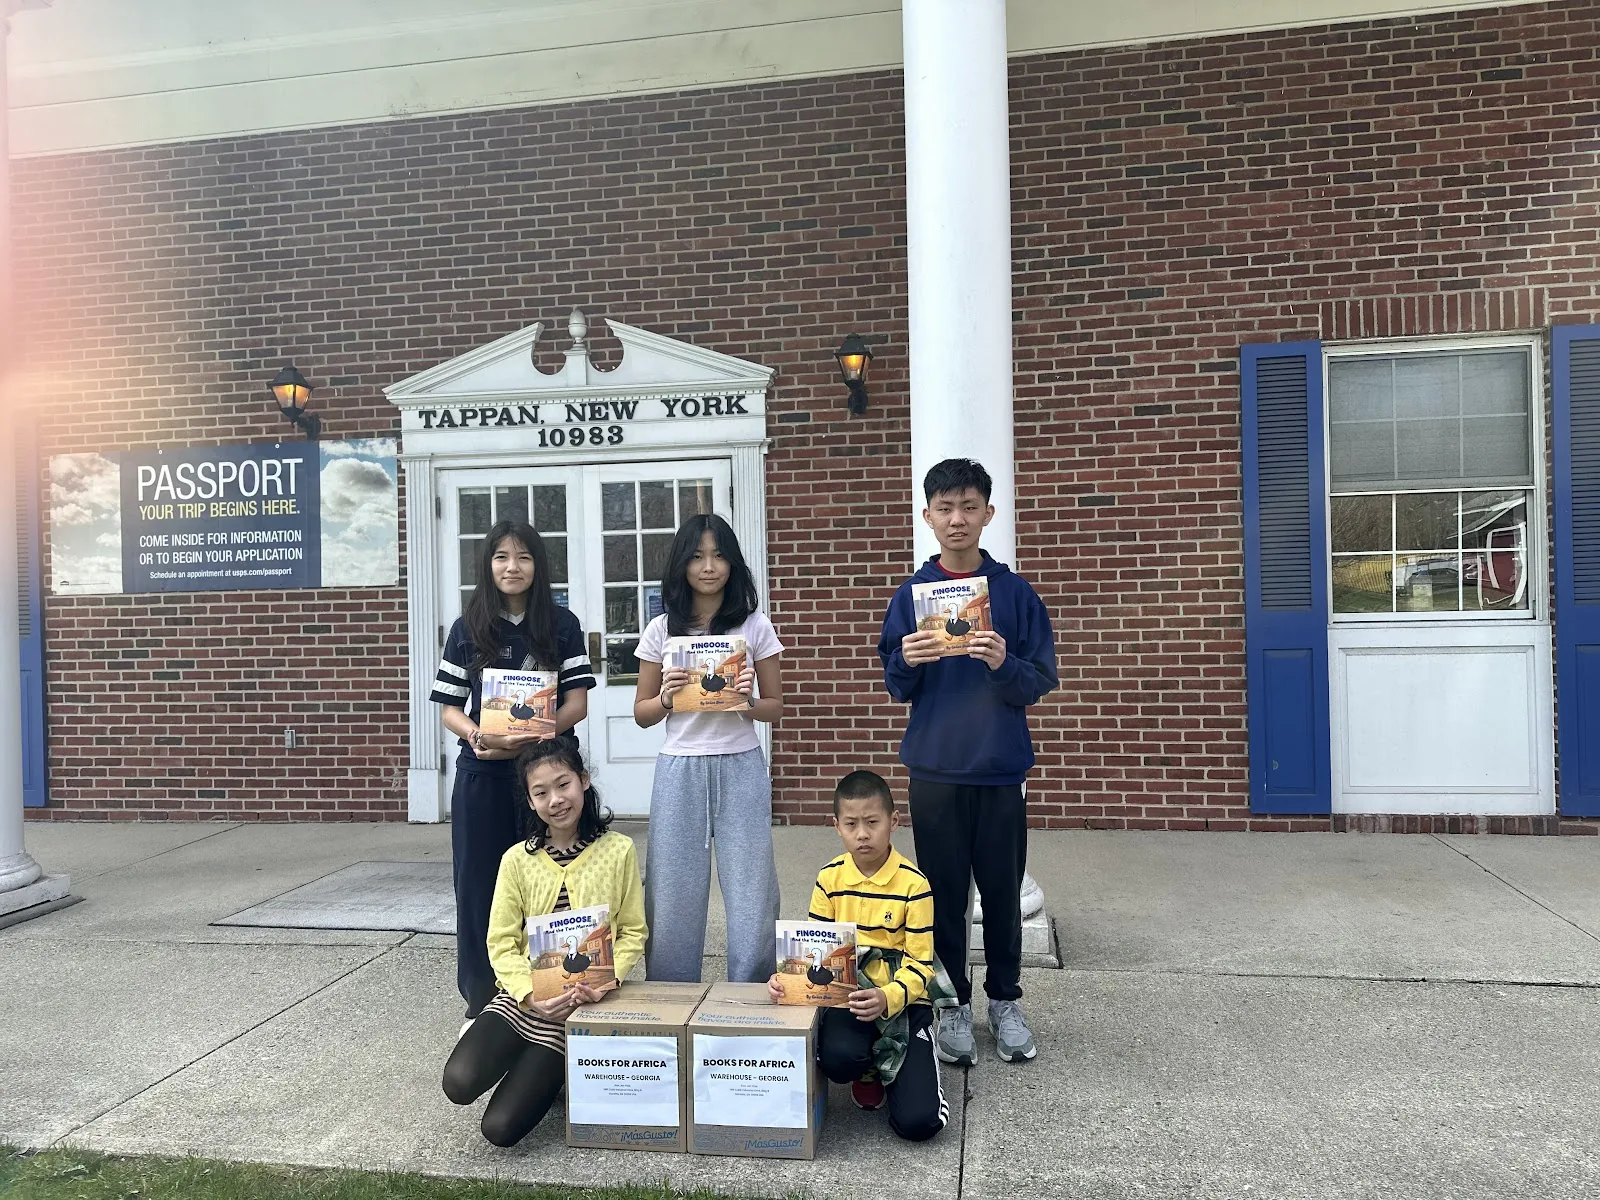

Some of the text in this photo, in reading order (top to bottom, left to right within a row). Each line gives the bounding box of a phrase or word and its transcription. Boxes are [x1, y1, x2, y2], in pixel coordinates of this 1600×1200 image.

[419, 396, 748, 429] TAPPAN, NEW YORK
[538, 426, 624, 447] 10983
[137, 458, 303, 501] PASSPORT
[139, 499, 300, 520] YOUR TRIP BEGINS HERE.
[139, 530, 302, 547] COME INSIDE FOR INFORMATION
[139, 548, 303, 565] OR TO BEGIN YOUR APPLICATION
[150, 571, 177, 579] Schedule
[187, 570, 223, 579] appointment
[232, 568, 292, 577] usps.com/passport
[932, 586, 971, 596] FINGOOSE
[549, 916, 592, 929] FINGOOSE
[796, 930, 836, 939] FINGOOSE
[578, 1059, 610, 1067] BOOKS
[703, 1059, 737, 1067] BOOKS
